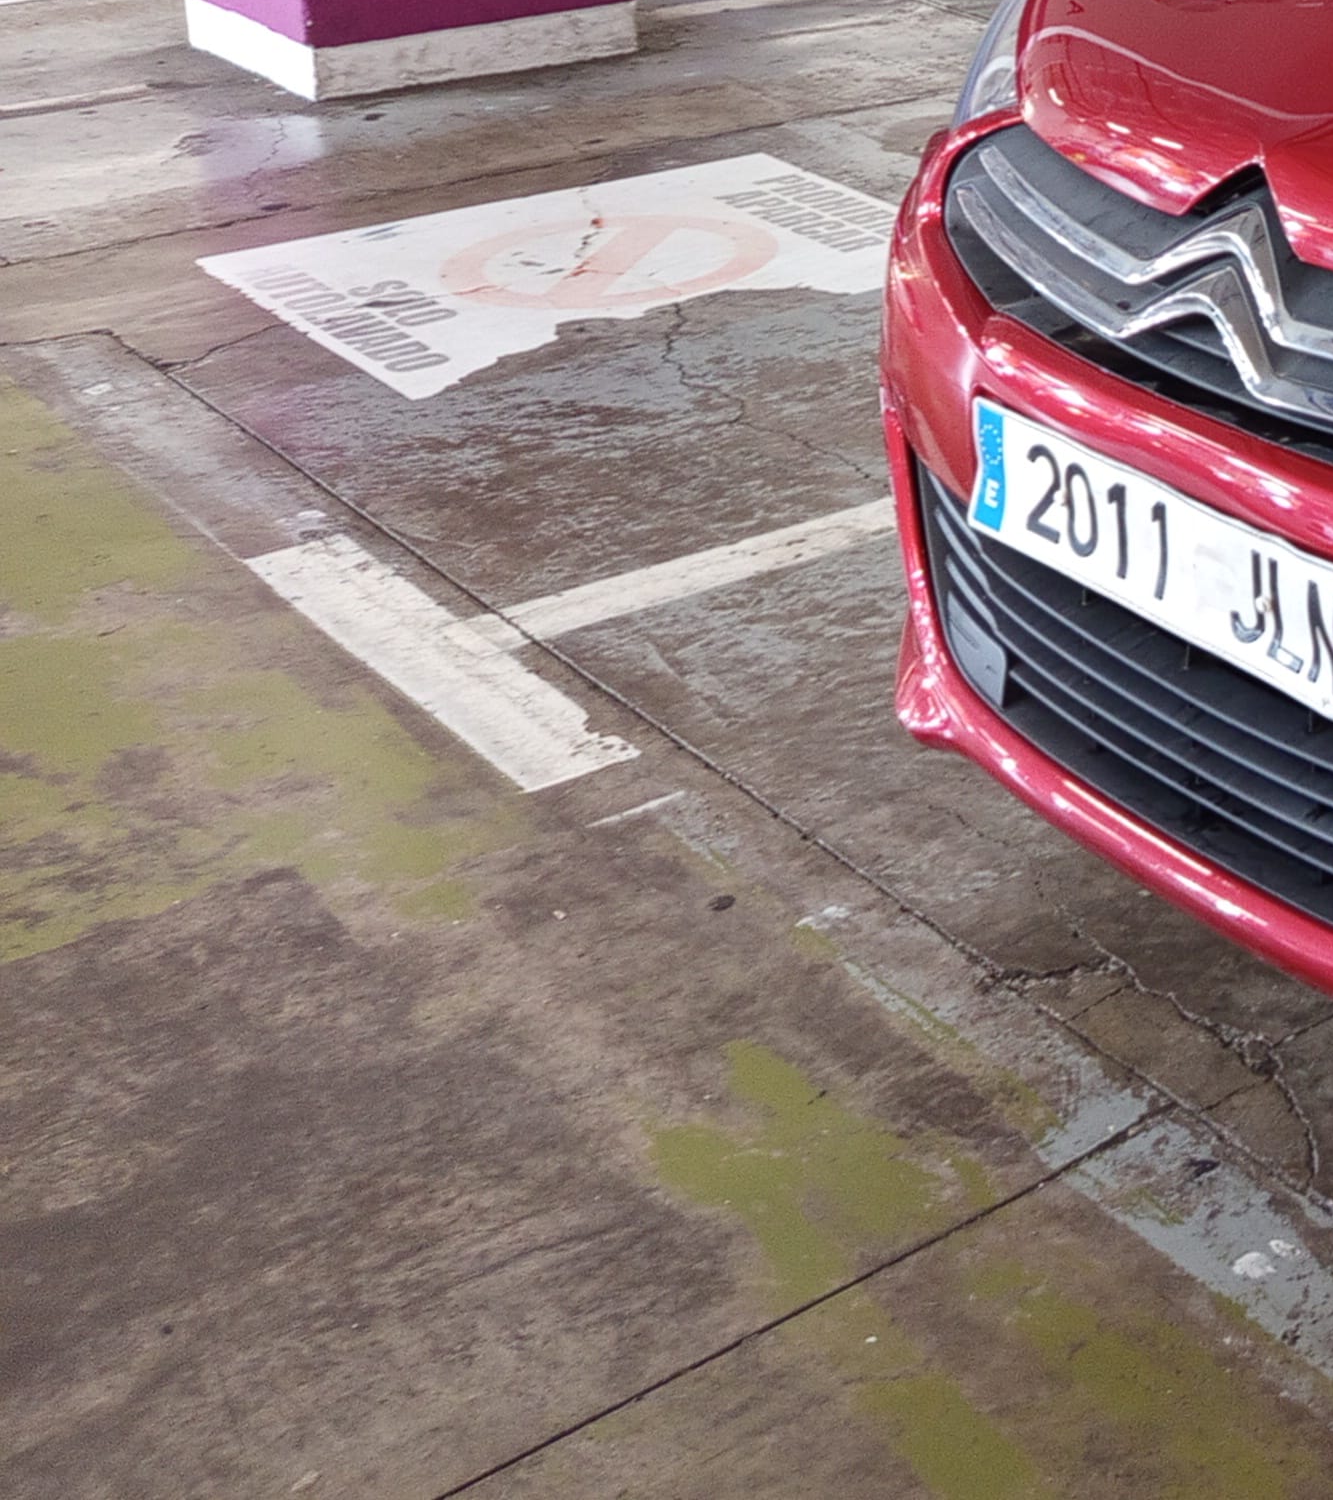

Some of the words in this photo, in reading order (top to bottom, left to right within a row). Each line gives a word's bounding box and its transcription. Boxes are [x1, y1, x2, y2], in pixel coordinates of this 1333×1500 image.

[712, 189, 887, 253] APARCAR
[751, 173, 896, 238] PROHIBI
[983, 480, 998, 508] E
[1026, 443, 1168, 601] 2011
